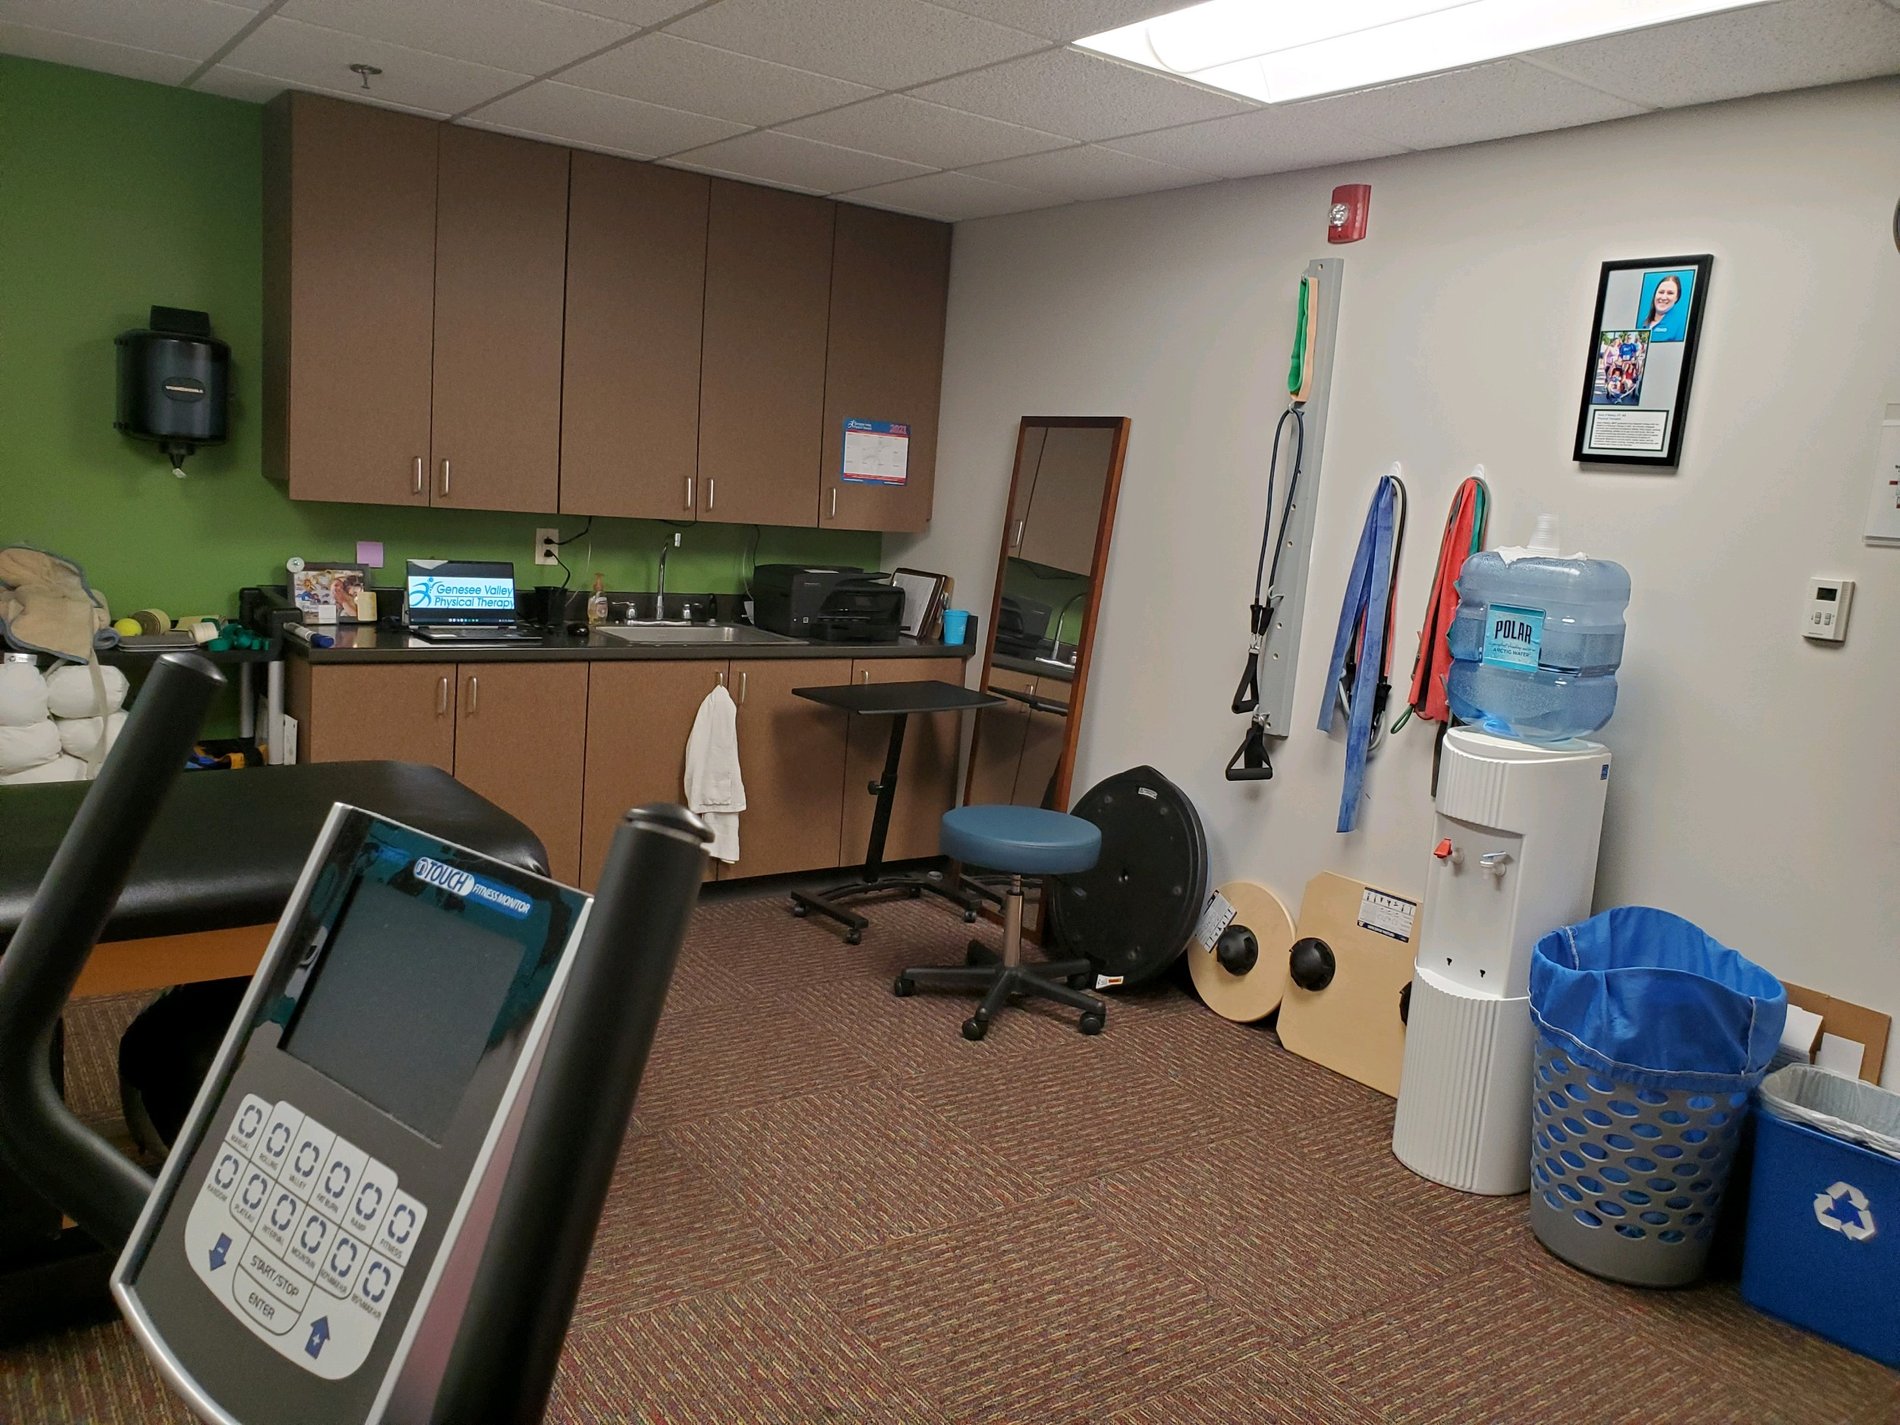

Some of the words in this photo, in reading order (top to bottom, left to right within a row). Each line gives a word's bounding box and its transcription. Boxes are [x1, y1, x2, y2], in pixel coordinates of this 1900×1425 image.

[436, 583, 481, 594] Genesee
[484, 585, 513, 597] Valley
[434, 597, 474, 608] Physical
[477, 598, 514, 609] Therapy
[1494, 620, 1532, 644] POLAR
[1493, 647, 1512, 655] ARCTIC
[472, 883, 499, 902] FITNESS
[498, 894, 531, 913] MONITOR
[259, 1153, 278, 1171] ROLLING
[289, 1174, 307, 1190] VALLEY
[207, 1183, 228, 1201] RANDOM
[234, 1203, 255, 1222] PLATEAU
[324, 1199, 338, 1213] BURN
[350, 1217, 366, 1231] RAMP
[262, 1225, 284, 1246] INTERVAL
[291, 1246, 315, 1269] MOUNTAIN
[380, 1238, 402, 1259] FITNESS
[250, 1255, 299, 1296] START/STOP
[248, 1292, 275, 1320] ENTER
